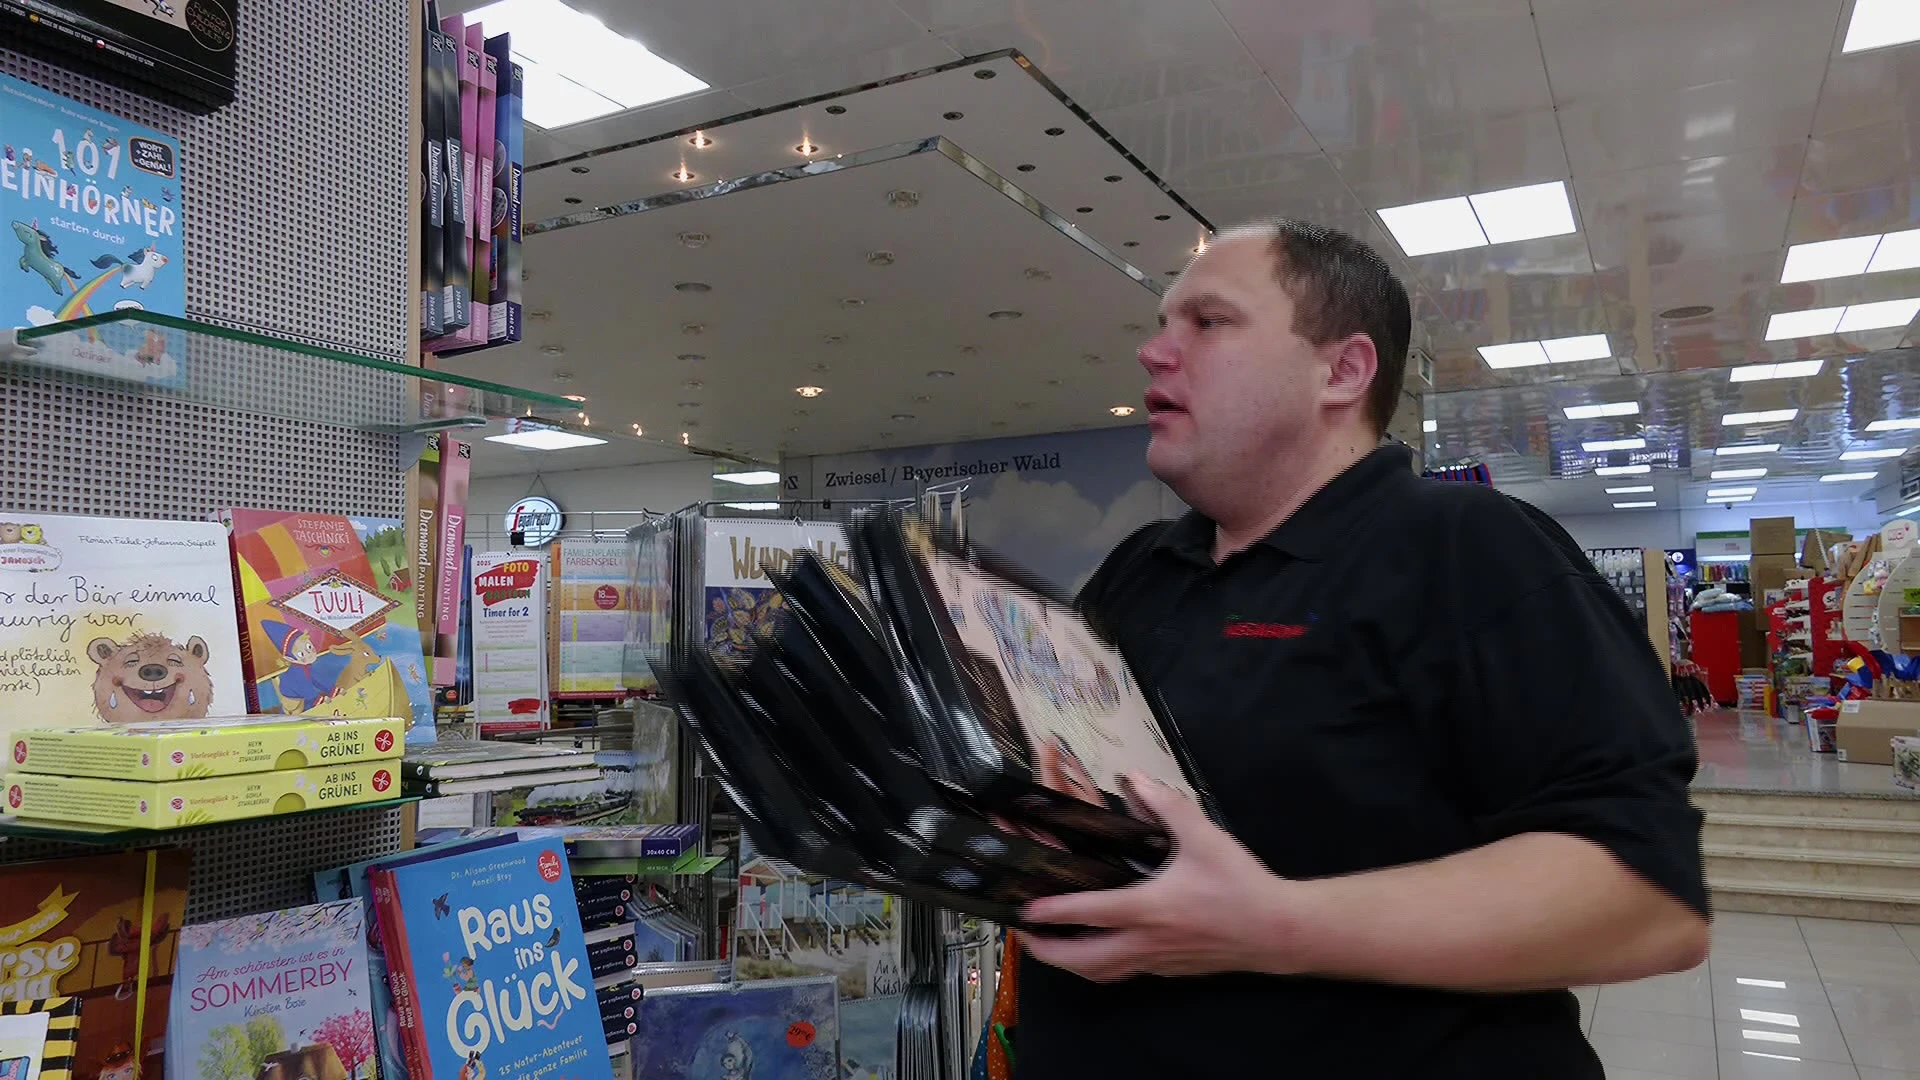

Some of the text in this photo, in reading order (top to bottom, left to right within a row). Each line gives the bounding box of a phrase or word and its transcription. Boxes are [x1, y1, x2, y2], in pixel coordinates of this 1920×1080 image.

[52, 128, 121, 180] 101
[138, 141, 163, 152] WORT
[1, 157, 176, 238] EINHÖRNER
[50, 216, 125, 244] starten durch!
[825, 467, 886, 488] Zwiesel
[902, 460, 1008, 484] Bayerischer
[1012, 453, 1061, 472] Wald
[297, 519, 345, 531] STEFANIE
[417, 509, 433, 618] Diamond PAINTING
[442, 515, 462, 621] Diamond PAINTING
[503, 562, 530, 573] FOTO
[566, 557, 618, 566] FARBENSPIEL
[479, 576, 514, 587] MALEN
[25, 582, 68, 604] der
[68, 575, 123, 605] Bär
[130, 584, 220, 606] einmal
[84, 611, 143, 627] war
[483, 608, 507, 618] Timer
[522, 606, 529, 616] 2
[327, 730, 359, 742] AB INS
[320, 742, 365, 758] GRÜNE!
[325, 771, 356, 784] AB INS
[319, 783, 362, 800] GRÜNE!
[489, 857, 526, 871] Greenwood
[457, 893, 552, 960] Raus
[514, 941, 545, 970] ins
[197, 946, 346, 983] Am schönsten ist es in
[190, 958, 353, 1012] SOMMERBY
[244, 1003, 281, 1017] Kirsten
[446, 950, 586, 1059] Glück
[498, 1034, 583, 1076] 25 Natur-Abenteuer
[559, 1049, 588, 1065] Familie
